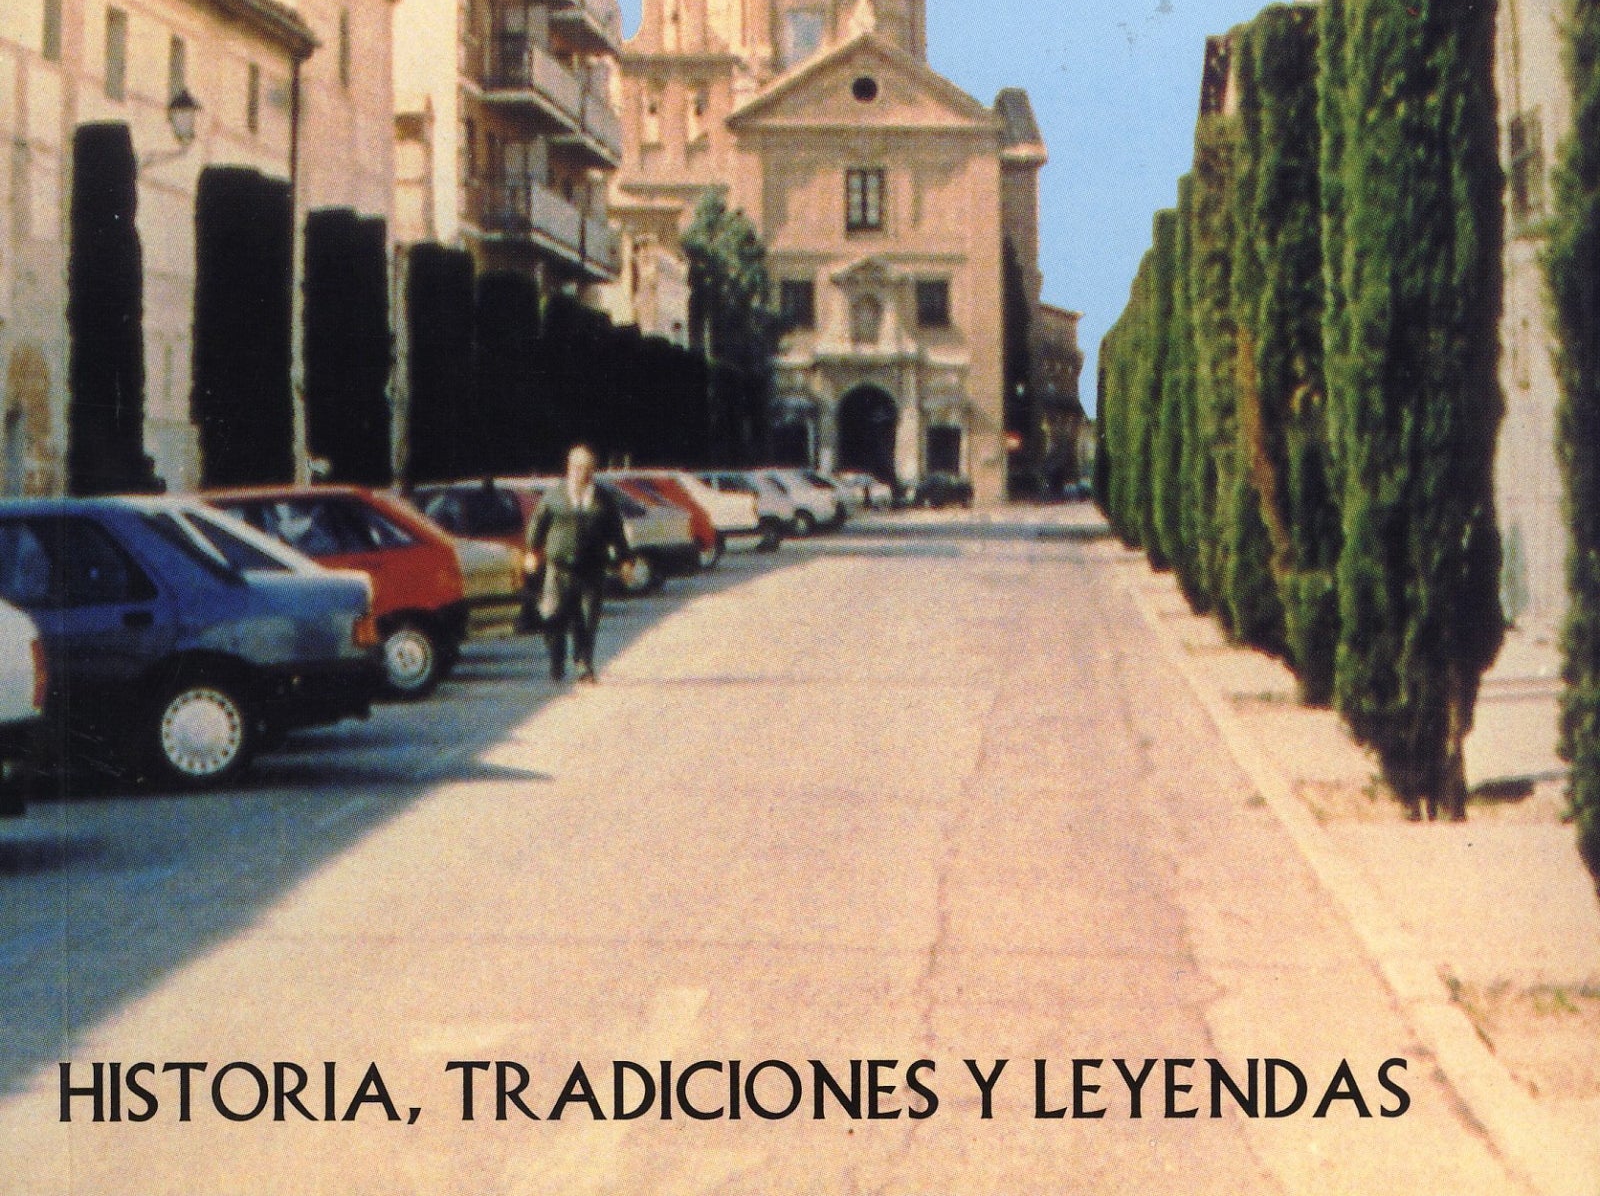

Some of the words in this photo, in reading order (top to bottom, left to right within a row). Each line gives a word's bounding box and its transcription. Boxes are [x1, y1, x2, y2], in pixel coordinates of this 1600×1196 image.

[58, 1061, 422, 1126] HISTORIA,
[445, 1059, 939, 1121] TRADICIONES
[963, 1059, 1009, 1119] Y
[1034, 1057, 1412, 1119] LEYENDAS
